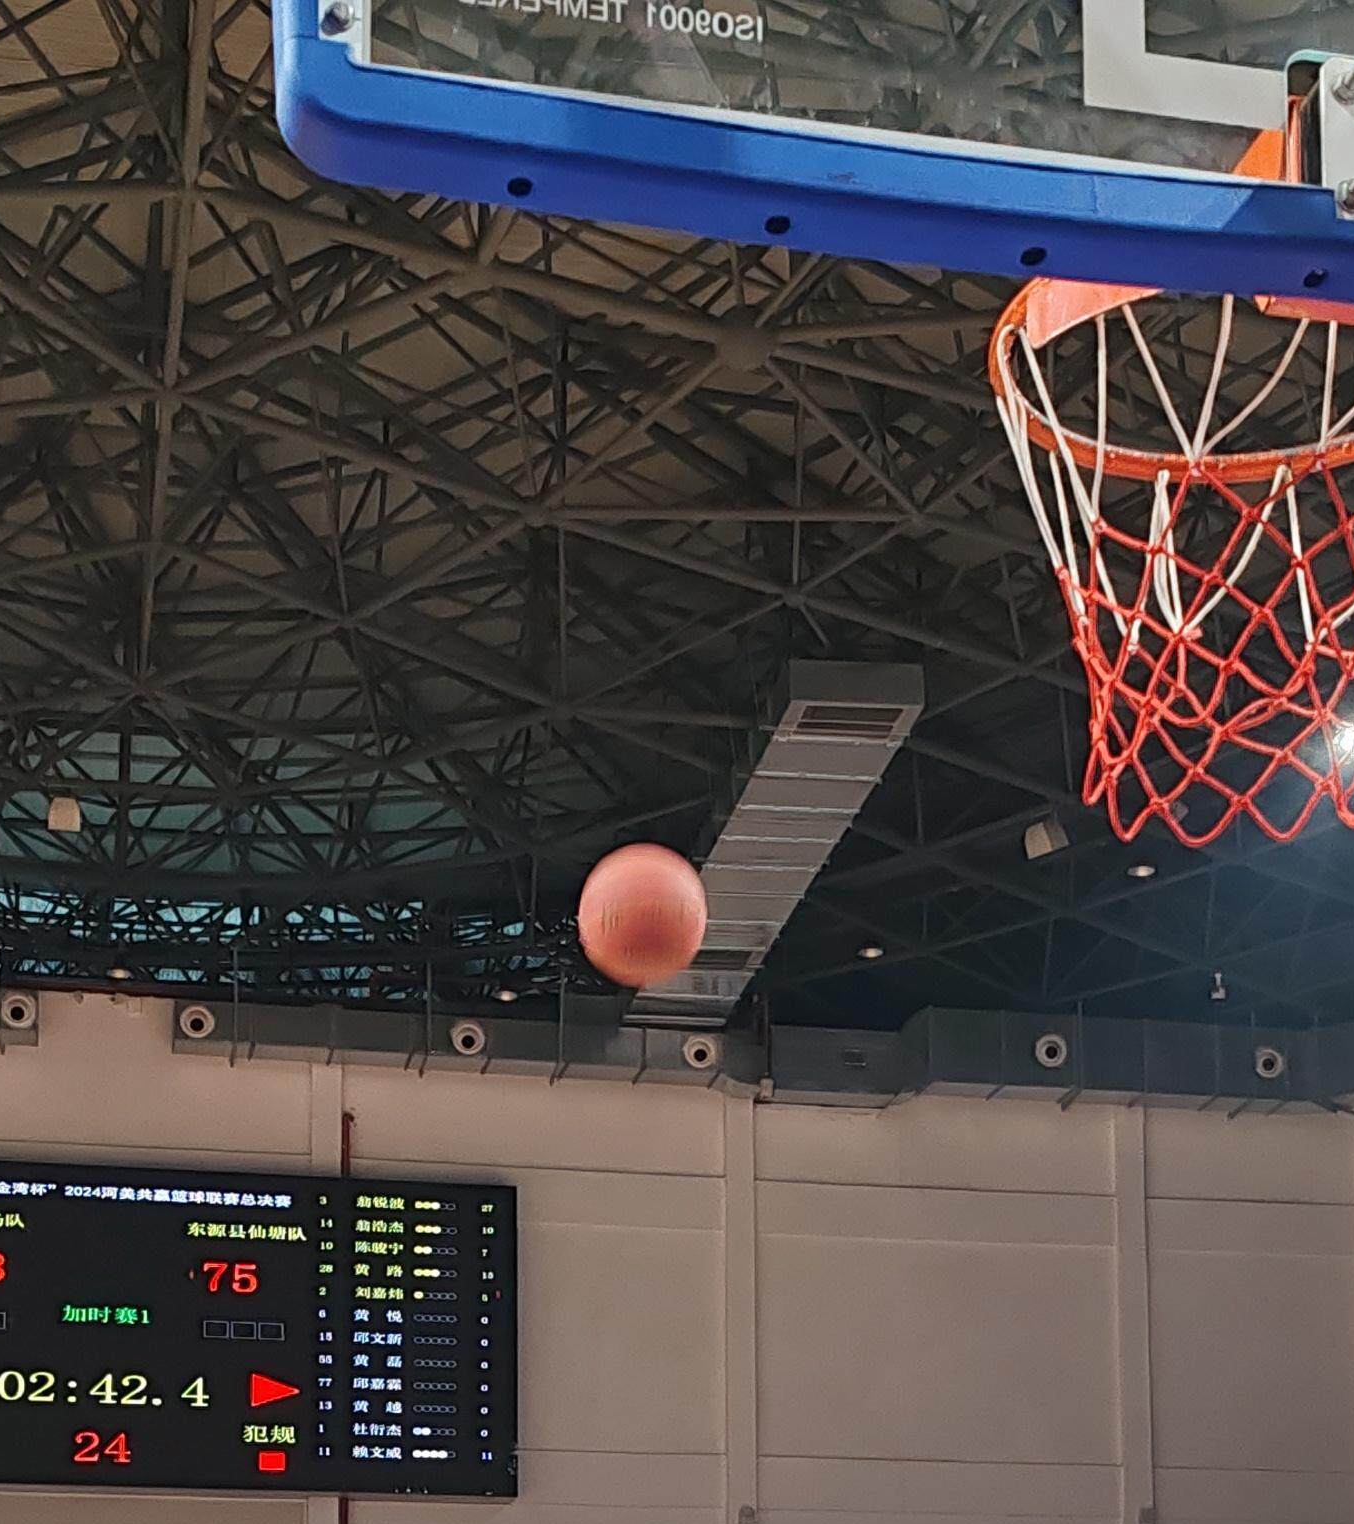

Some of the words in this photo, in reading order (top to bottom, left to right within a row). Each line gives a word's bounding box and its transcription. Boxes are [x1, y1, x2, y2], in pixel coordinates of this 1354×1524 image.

[319, 1196, 327, 1205] 3
[320, 1219, 333, 1228] 14
[187, 1221, 307, 1241] 东源县仙塘队
[320, 1241, 334, 1250] 10
[319, 1264, 333, 1273] 28
[204, 1262, 259, 1293] 75
[319, 1287, 327, 1296] 2
[62, 1306, 150, 1325] 加时赛1
[319, 1310, 326, 1318] 6
[319, 1332, 333, 1341] 15
[318, 1378, 333, 1387] 77
[318, 1401, 333, 1410] 13
[318, 1424, 324, 1433] 1
[243, 1425, 296, 1444] 犯规
[74, 1432, 132, 1463] 24
[318, 1447, 331, 1456] 11
